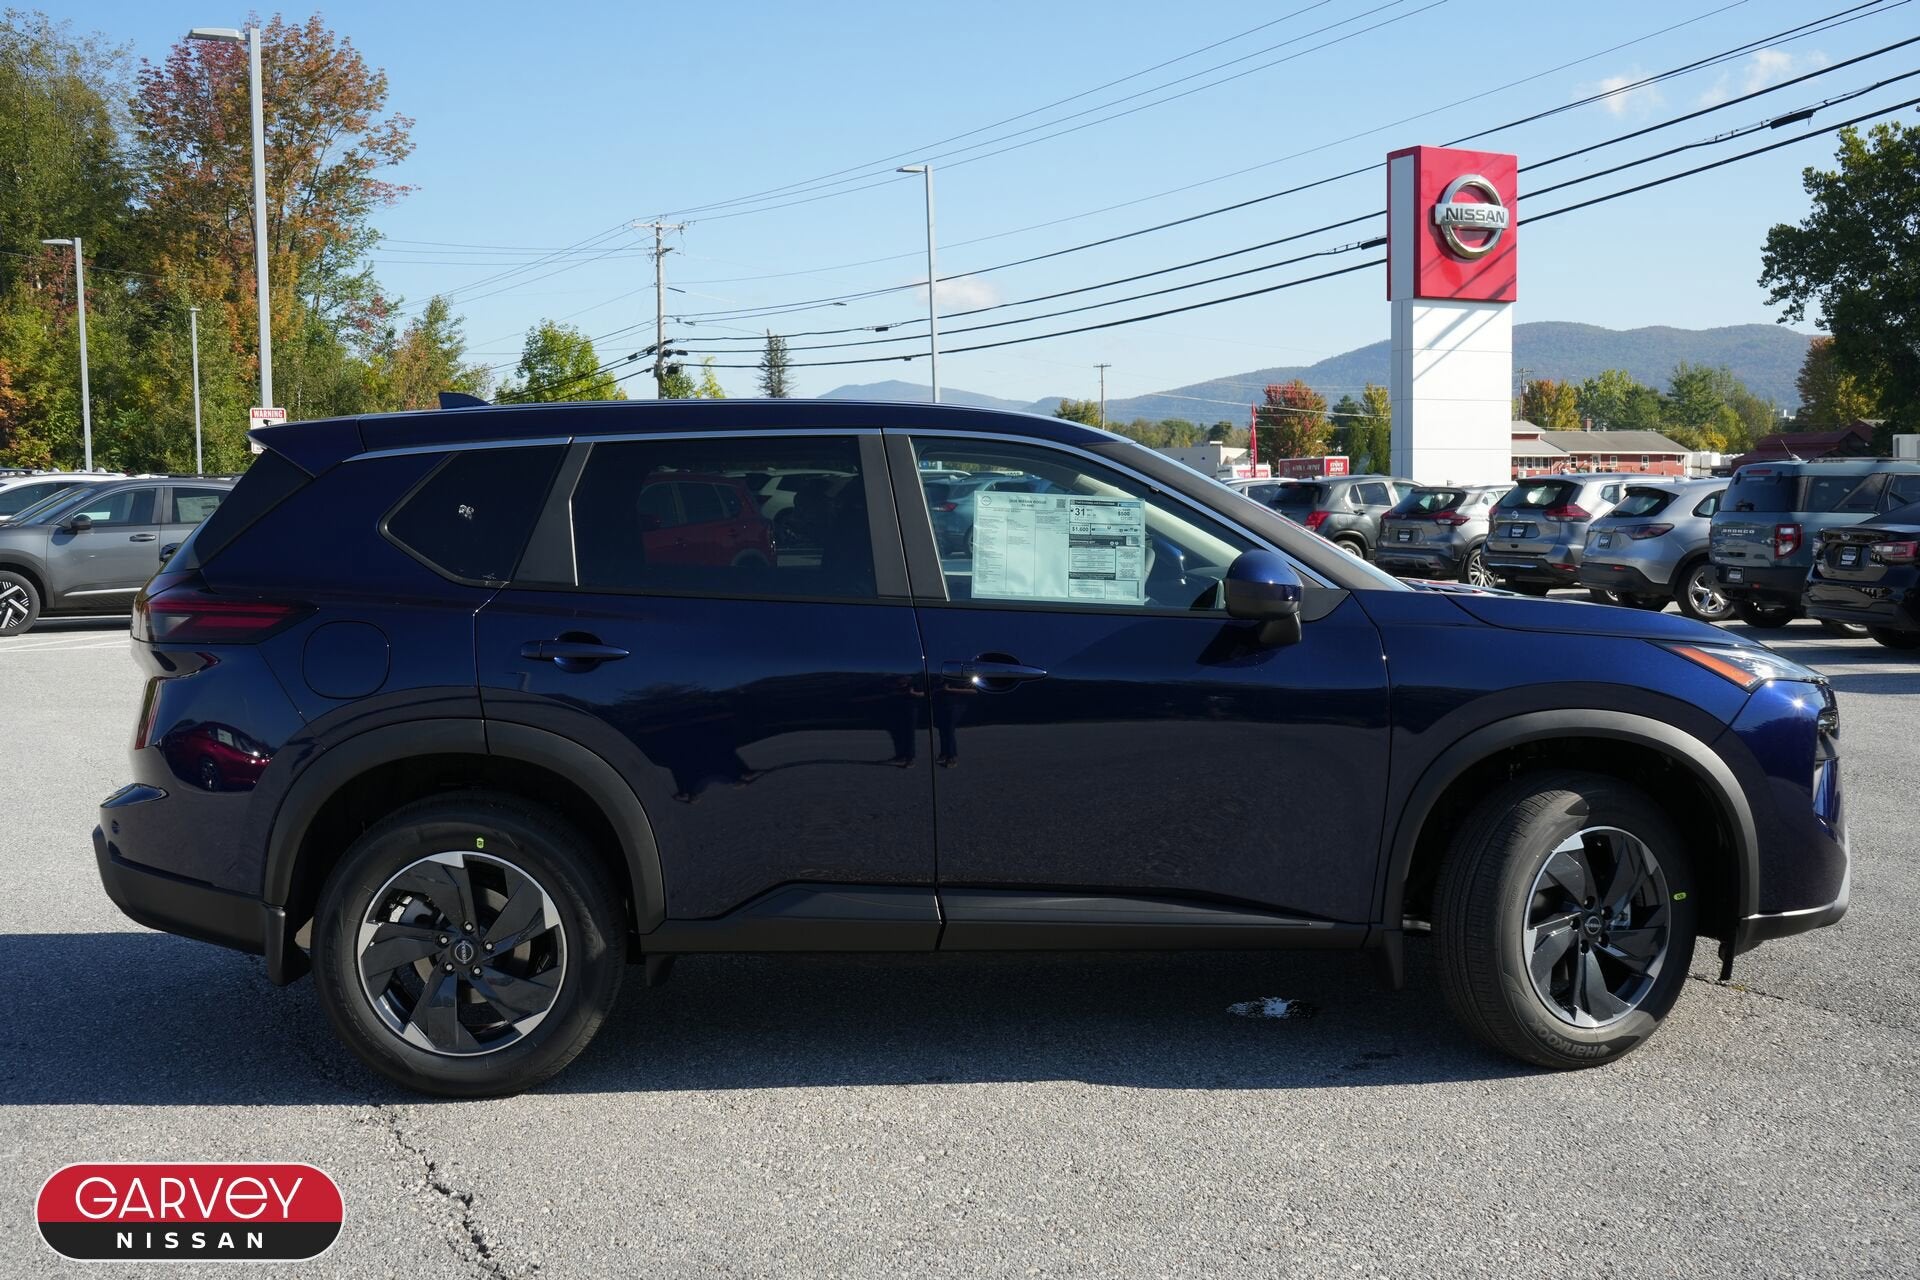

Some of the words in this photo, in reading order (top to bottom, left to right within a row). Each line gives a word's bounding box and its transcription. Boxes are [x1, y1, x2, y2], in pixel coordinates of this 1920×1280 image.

[1446, 207, 1505, 223] NISSAN
[253, 410, 283, 418] WARNING
[1074, 507, 1085, 516] 31
